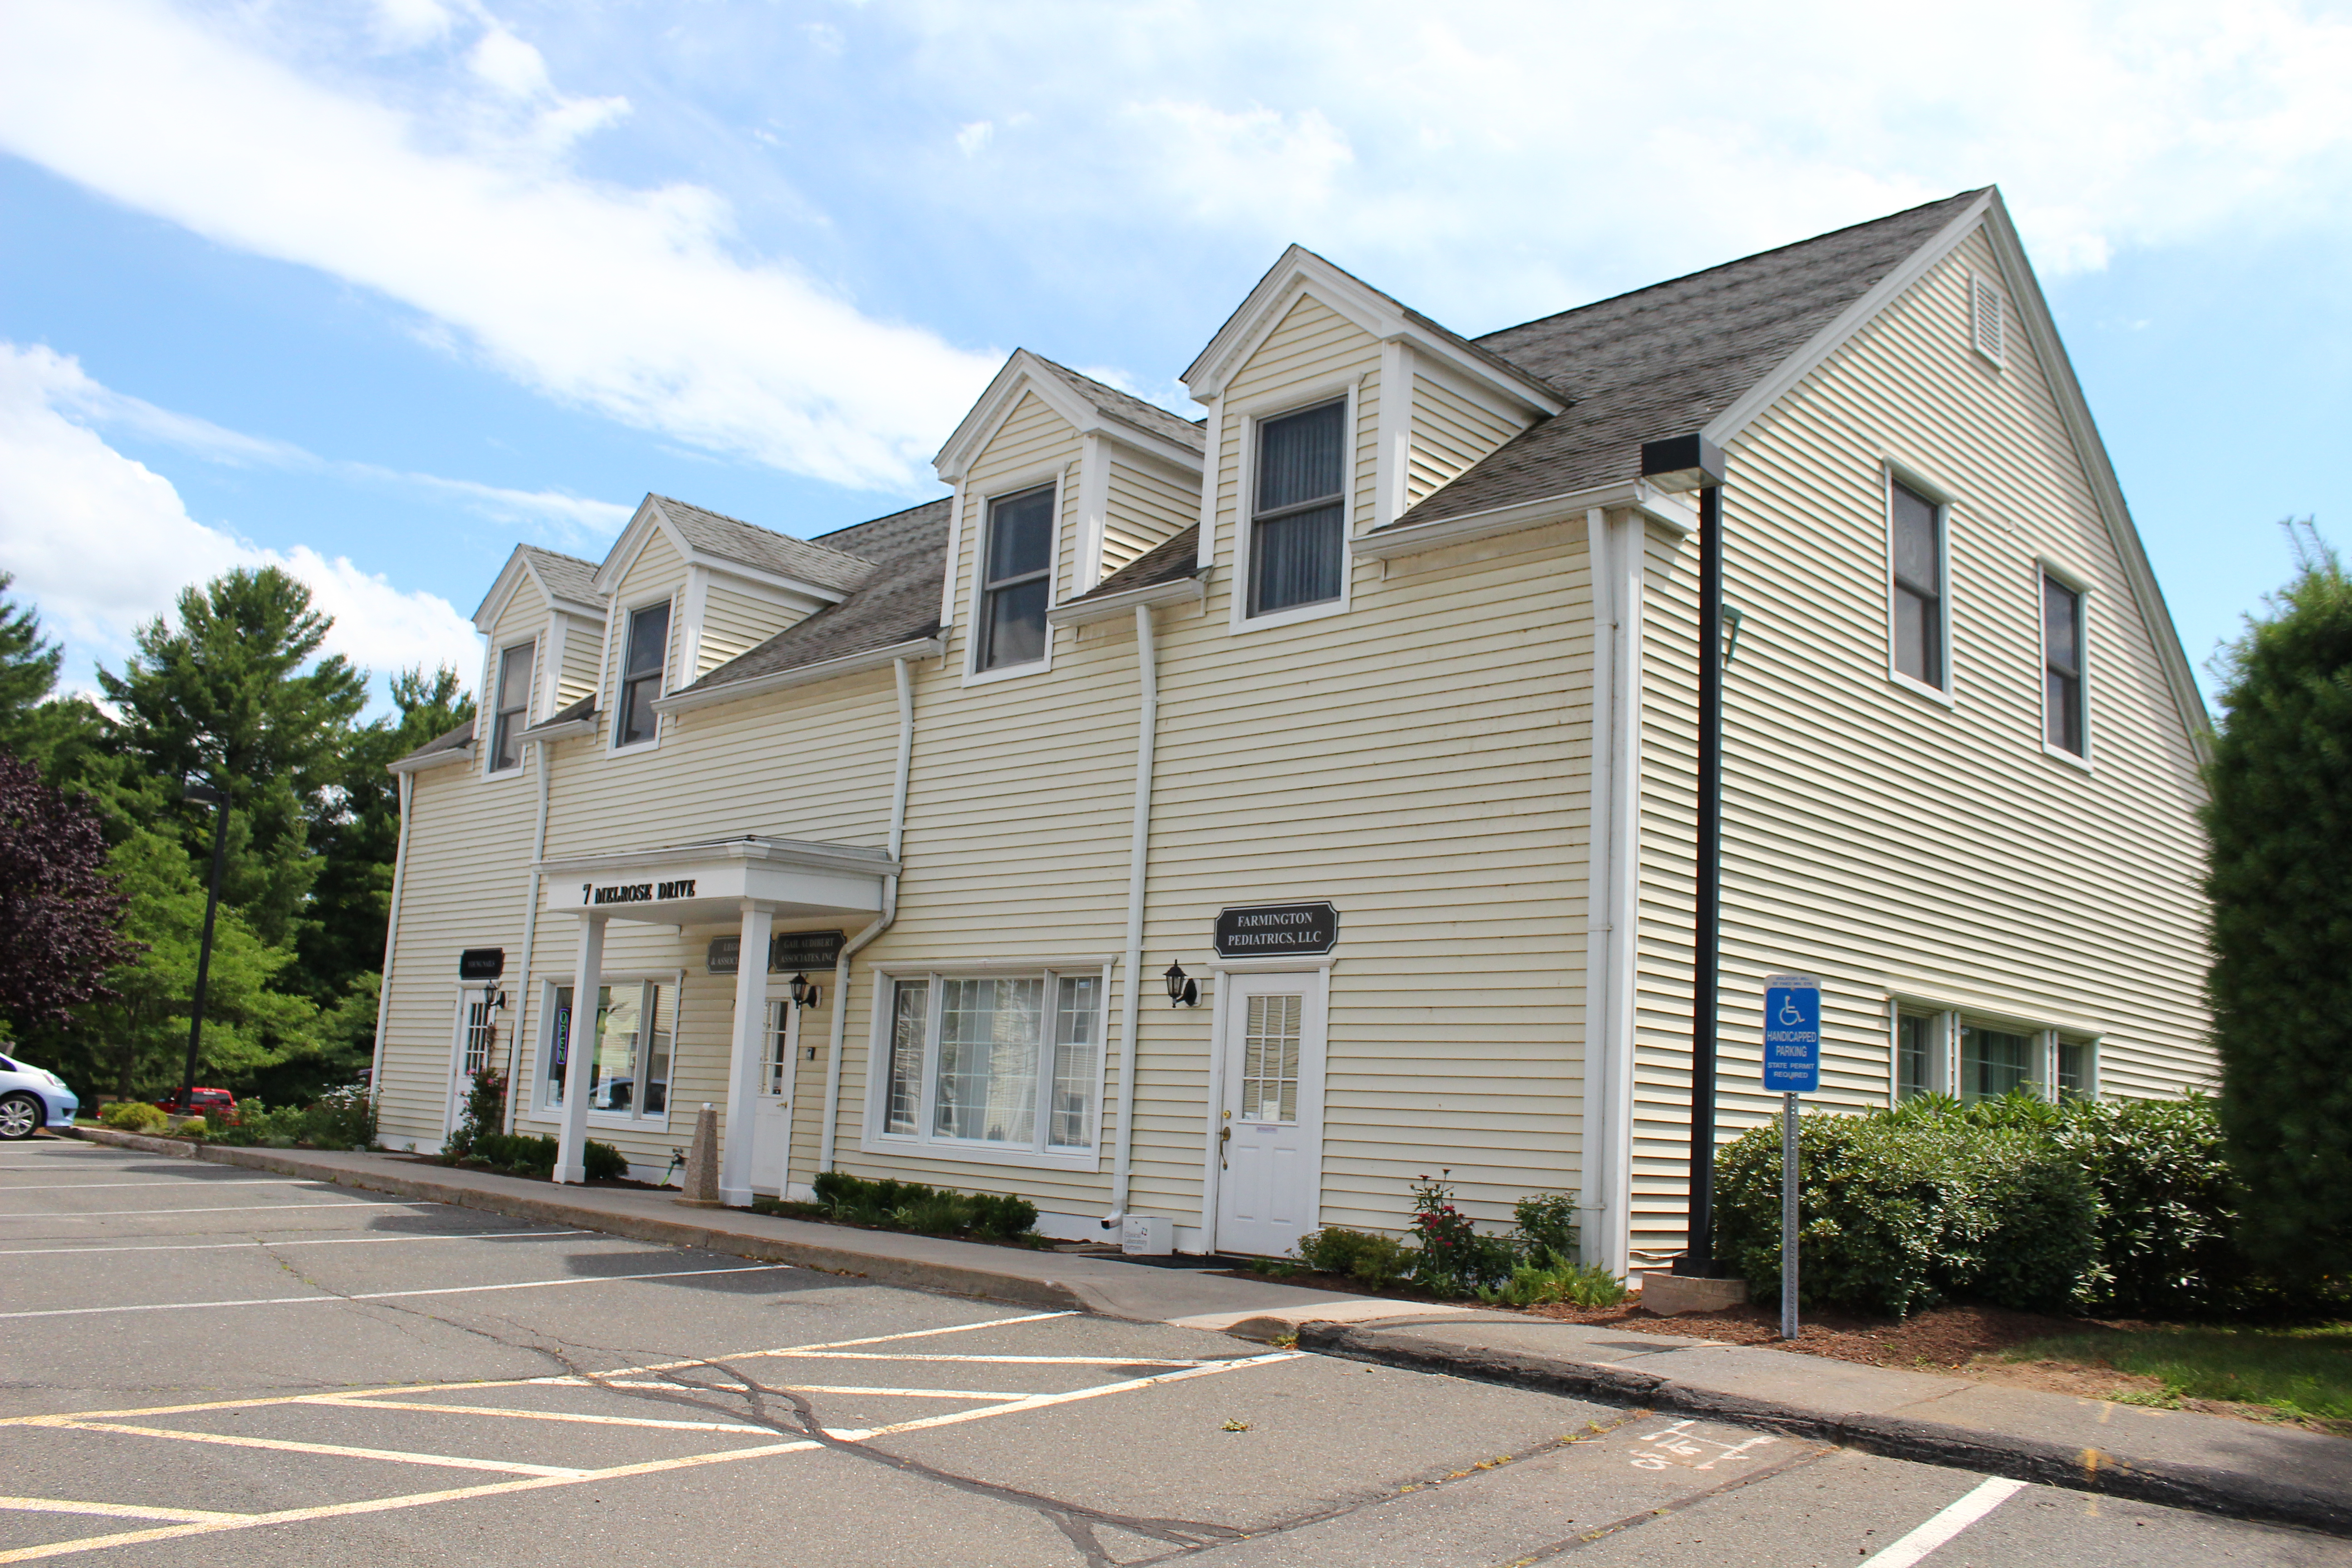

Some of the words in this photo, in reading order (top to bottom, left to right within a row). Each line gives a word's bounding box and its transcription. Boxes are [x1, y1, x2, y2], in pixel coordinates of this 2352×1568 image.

[583, 884, 591, 905] 7
[595, 883, 652, 904] MELROSE
[657, 879, 696, 899] DRIVE
[1238, 912, 1313, 927] FARMINGTON
[1228, 932, 1296, 946] PEDIATRICS,
[1298, 931, 1322, 943] LLC
[718, 956, 739, 965] ASSOCI
[1766, 1031, 1817, 1043] HANDICAPPED
[1776, 1046, 1807, 1057] PARKING
